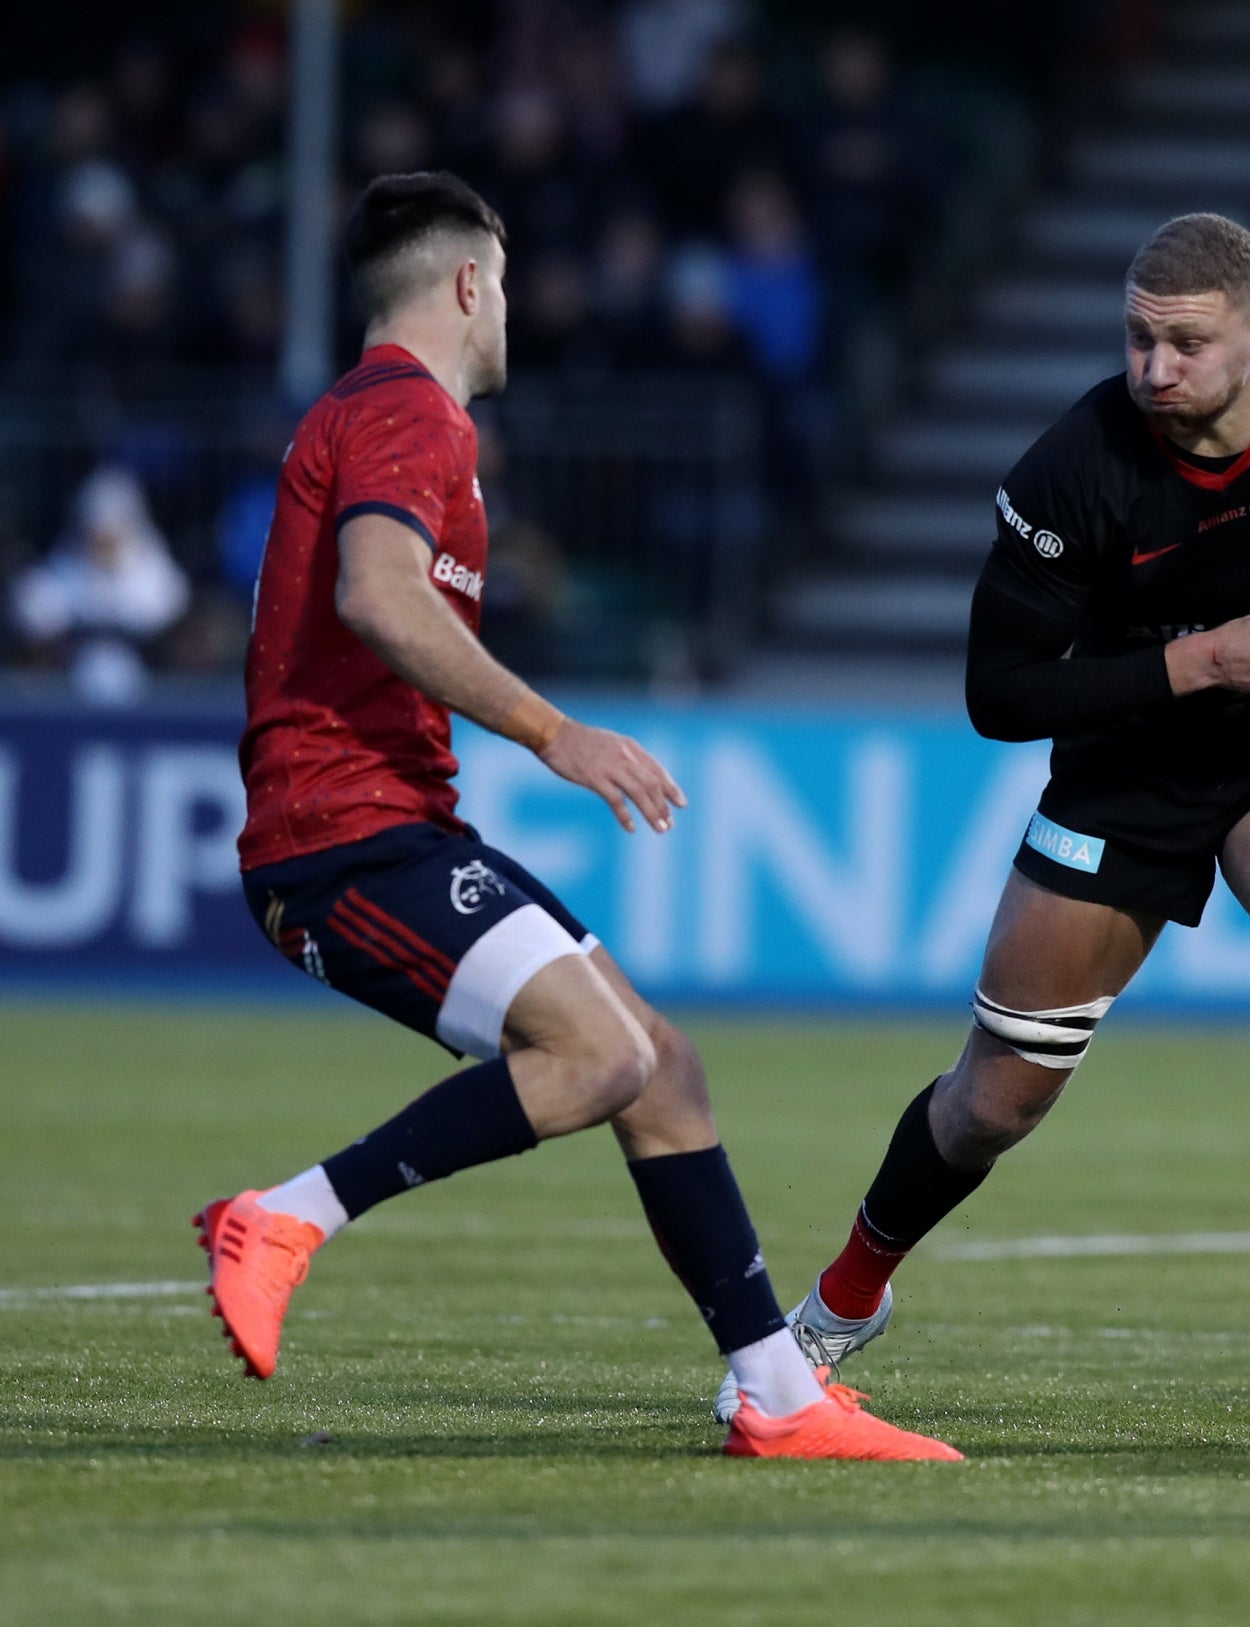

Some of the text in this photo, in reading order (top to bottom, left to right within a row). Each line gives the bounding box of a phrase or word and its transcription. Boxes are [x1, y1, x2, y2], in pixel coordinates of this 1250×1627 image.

[996, 485, 1033, 540] llianz
[1198, 506, 1247, 532] Allianz
[433, 551, 484, 602] Bank
[1030, 820, 1091, 866] SIMBA
